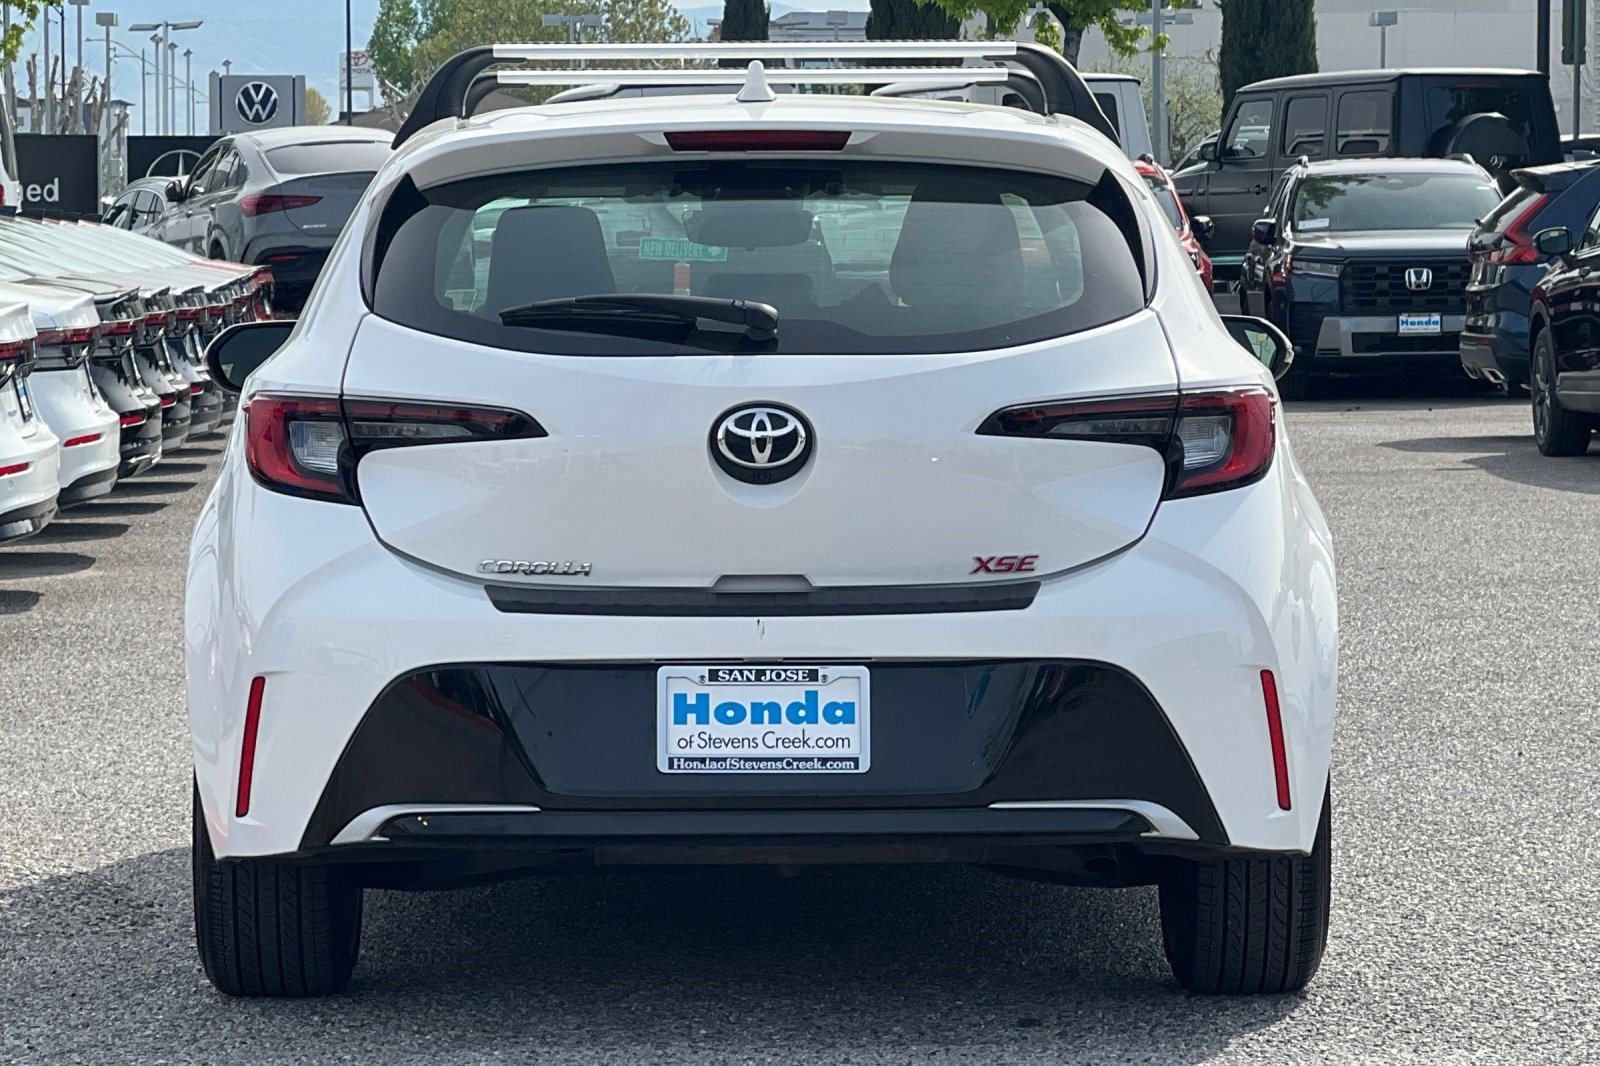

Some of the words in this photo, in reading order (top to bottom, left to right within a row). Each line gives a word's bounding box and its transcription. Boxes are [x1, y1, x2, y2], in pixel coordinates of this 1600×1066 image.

[341, 67, 371, 75] TYOTA
[1401, 317, 1439, 326] Honda
[477, 559, 592, 576] COROLLA
[969, 555, 1039, 574] XSE
[717, 669, 756, 682] SAN
[760, 669, 810, 682] JOSE
[673, 690, 856, 725] Honda
[677, 734, 695, 749] of
[697, 731, 759, 749] Stevens
[762, 729, 851, 749] Creek.com
[673, 758, 855, 770] HondaofStevensCreek.com
